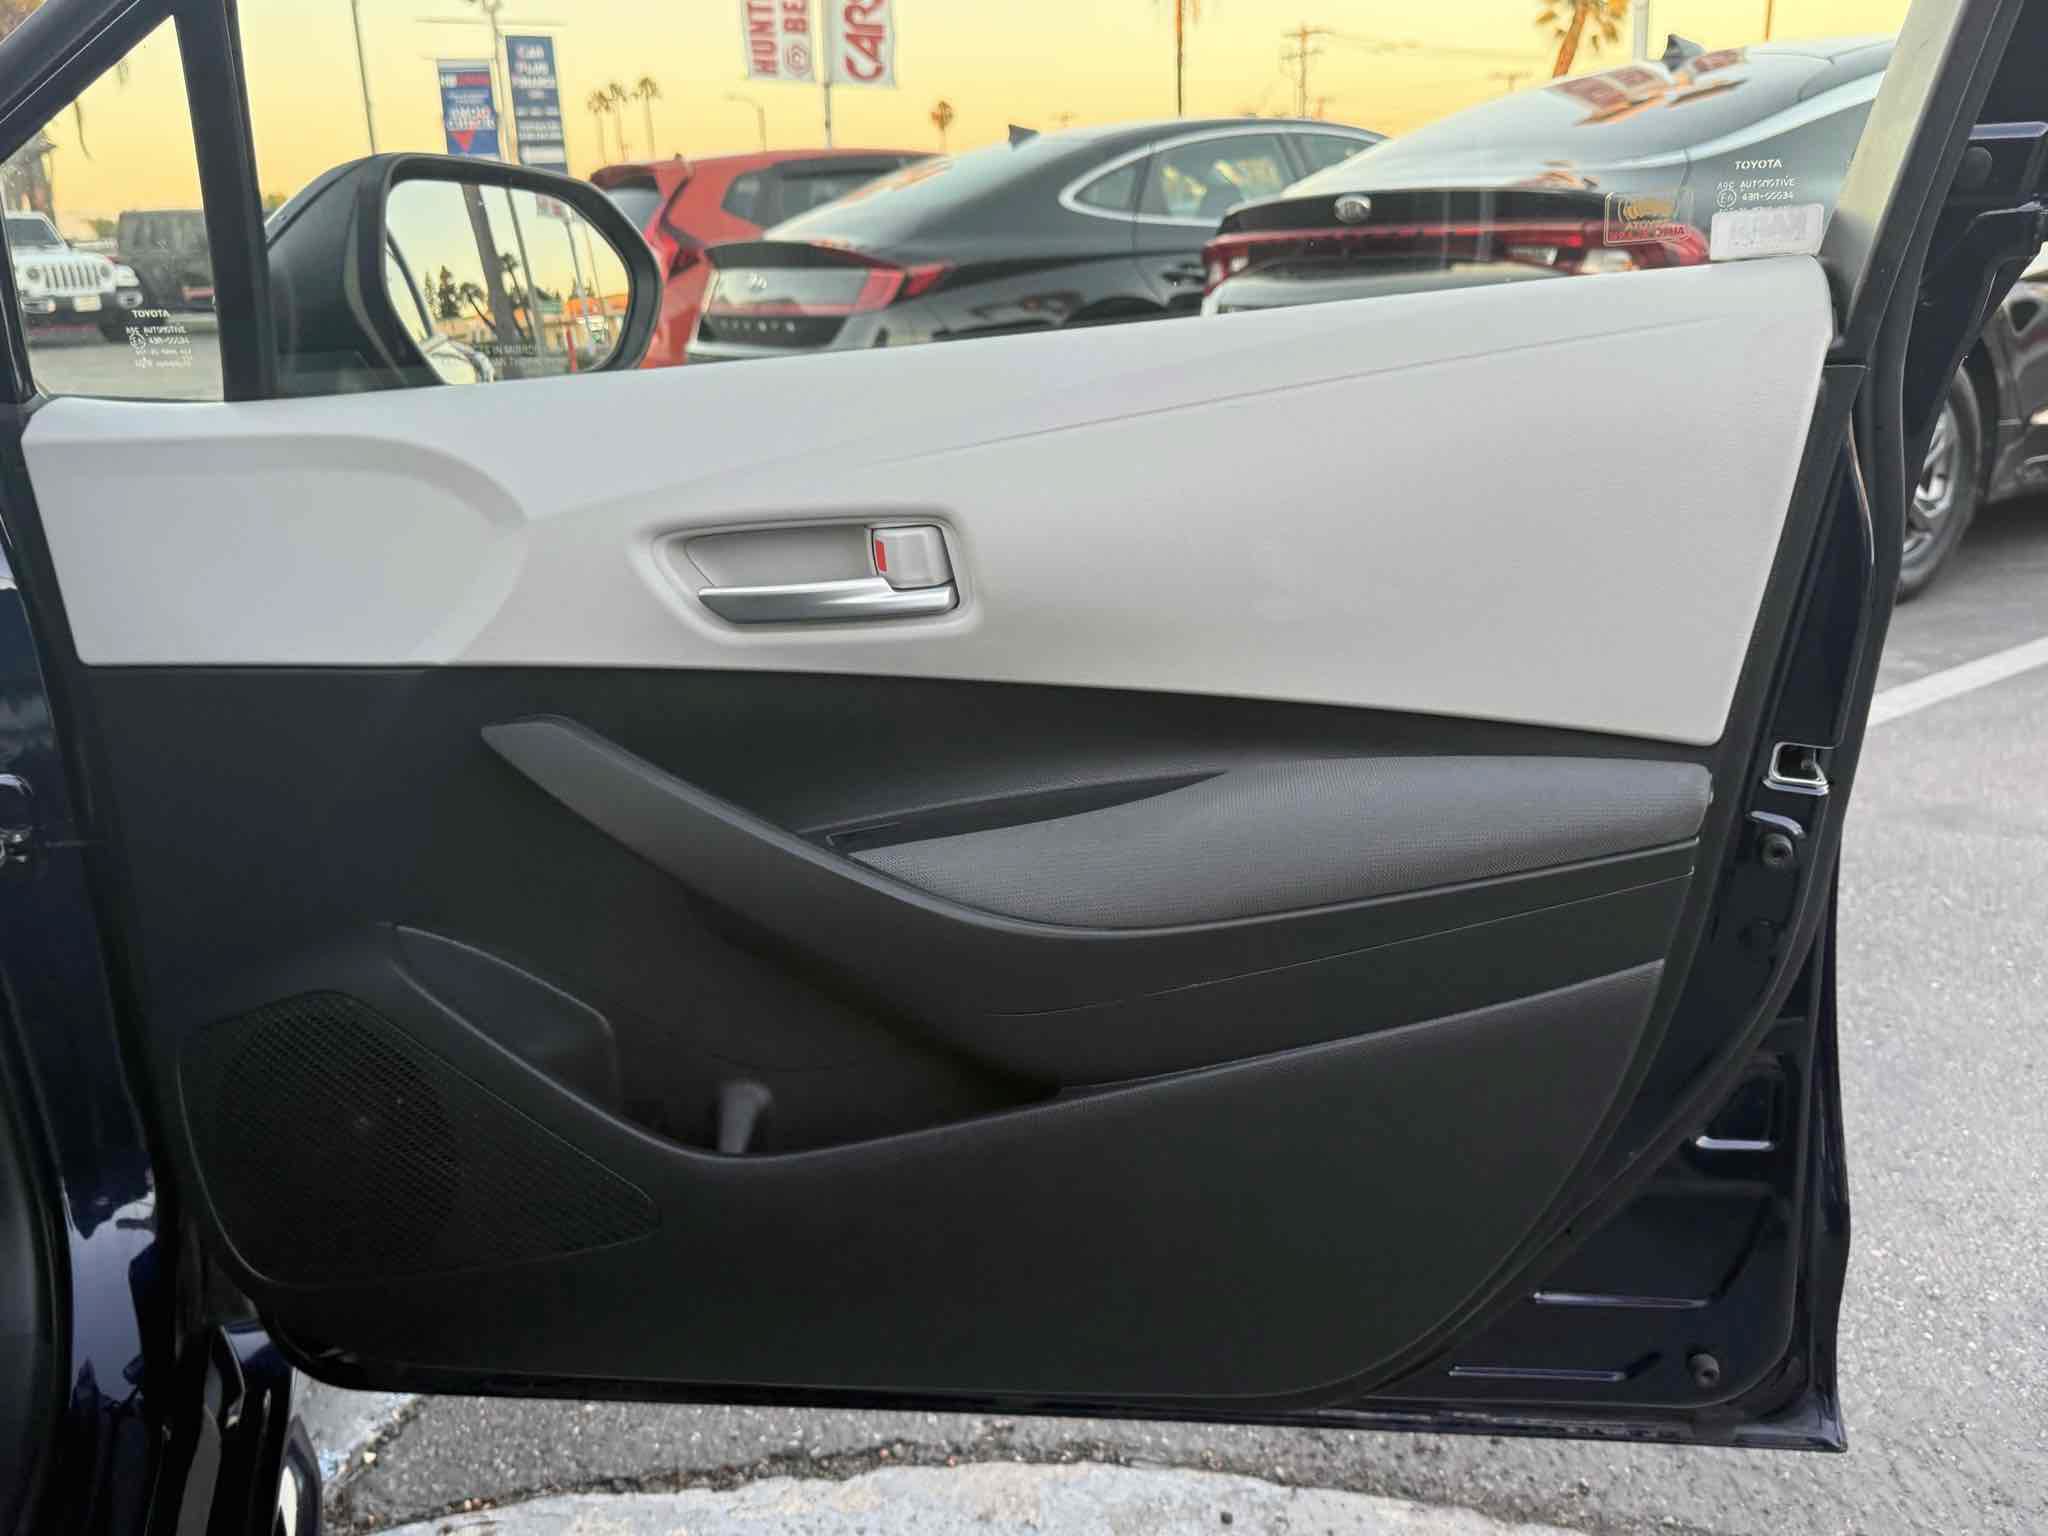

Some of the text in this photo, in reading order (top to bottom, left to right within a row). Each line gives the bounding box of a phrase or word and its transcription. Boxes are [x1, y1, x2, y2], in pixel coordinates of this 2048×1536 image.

[843, 0, 884, 81] CAR
[1735, 159, 1784, 170] TOYOTA
[1740, 176, 1797, 190] AUTOMOTIVE
[131, 308, 171, 319] TOYOTA
